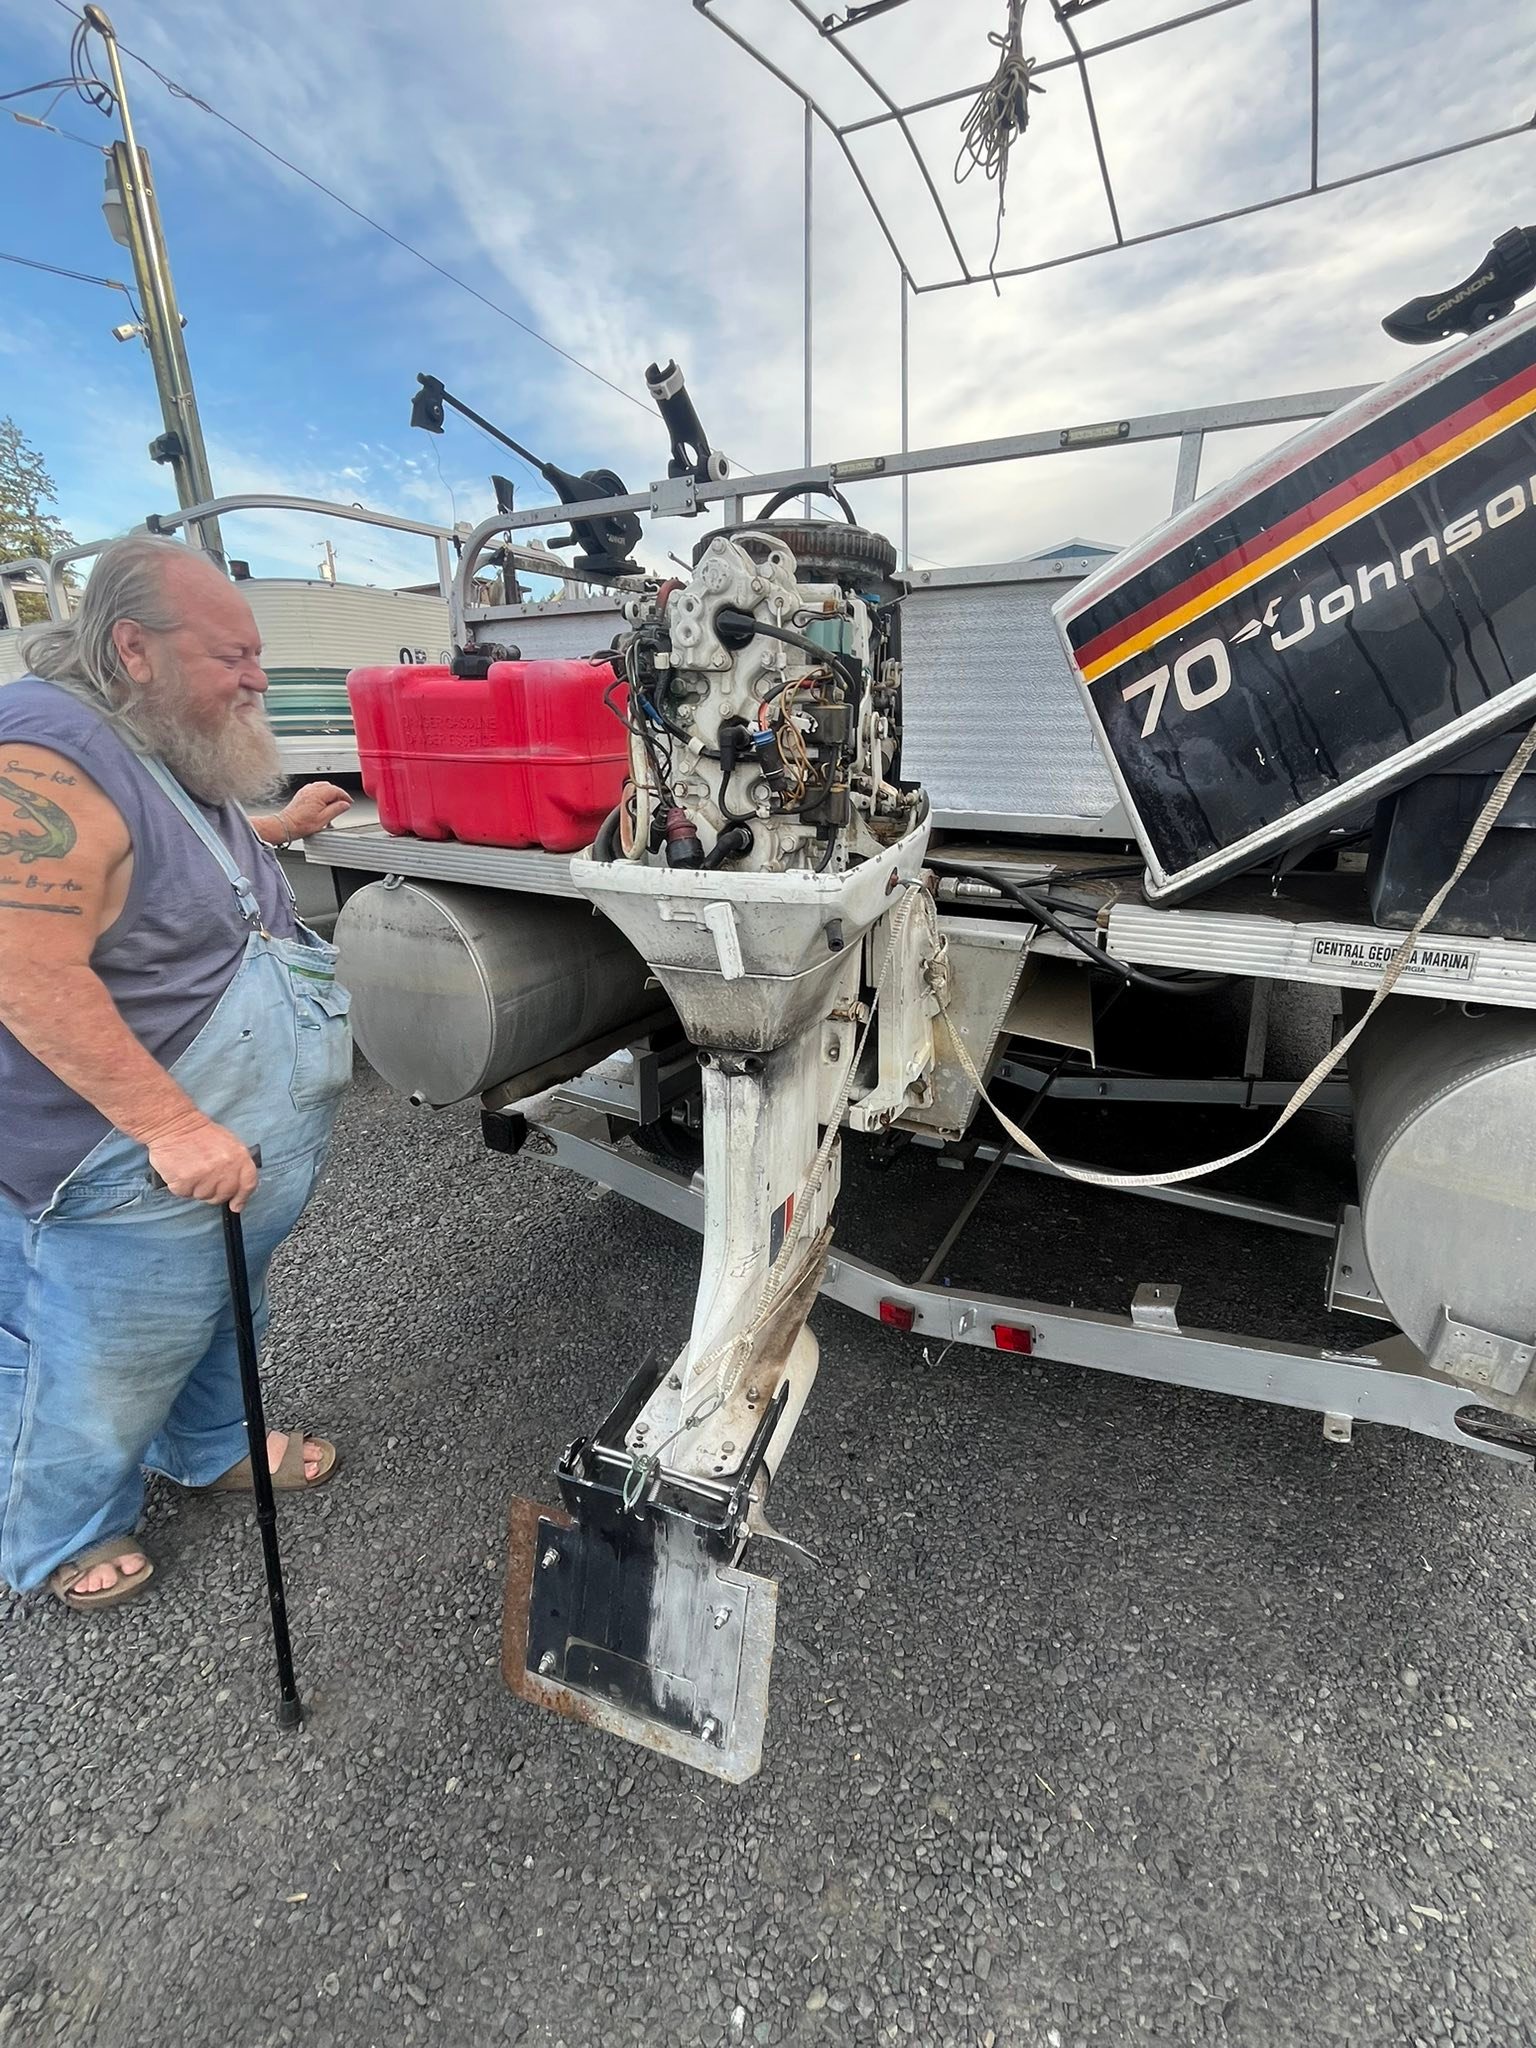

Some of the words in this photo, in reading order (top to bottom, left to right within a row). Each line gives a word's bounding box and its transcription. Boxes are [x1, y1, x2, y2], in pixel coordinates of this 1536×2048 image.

[1426, 271, 1496, 321] CANNON
[1121, 637, 1232, 739] 70
[1271, 474, 1536, 651] Johnso
[1316, 940, 1364, 959] CENTRAL
[1368, 946, 1417, 965] GEORA
[1421, 951, 1469, 970] MARINA
